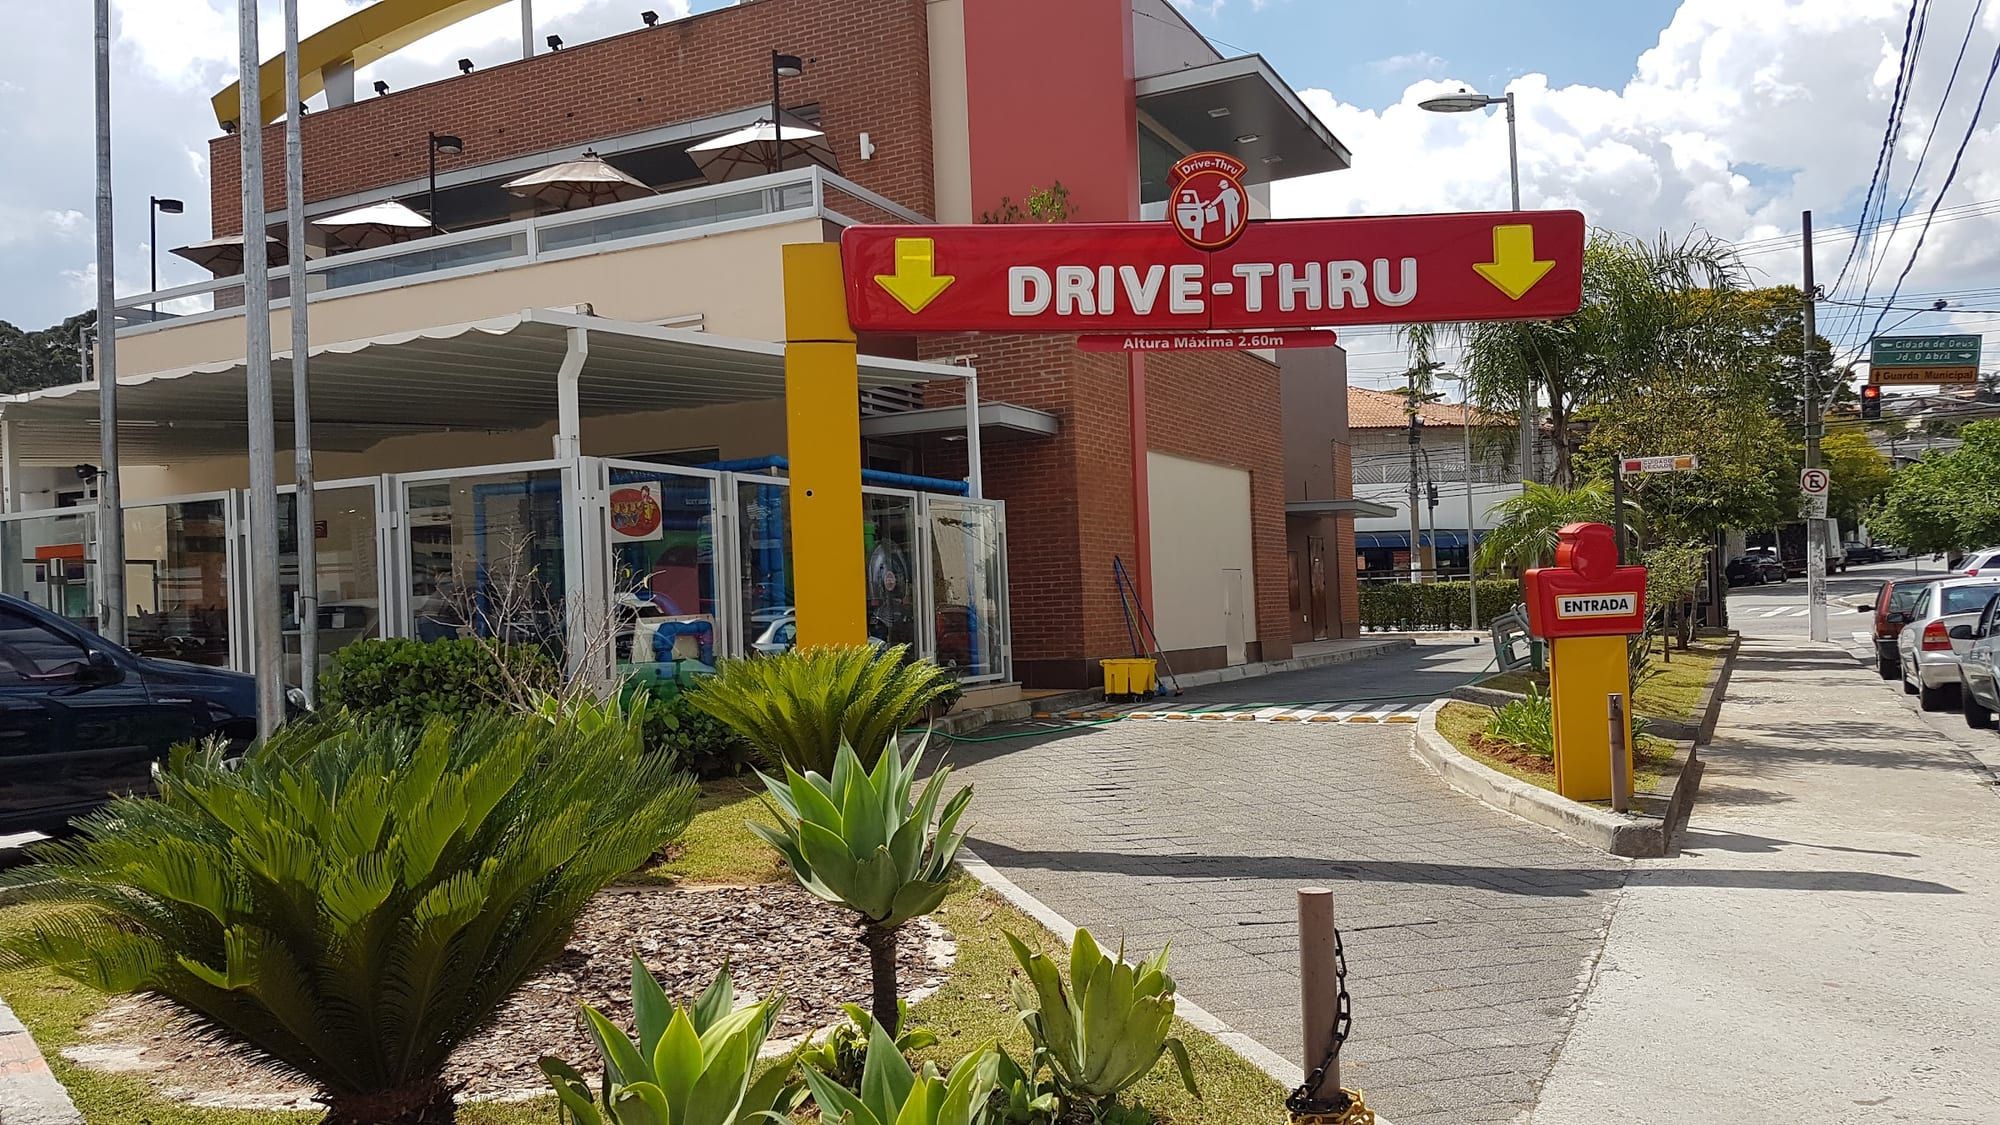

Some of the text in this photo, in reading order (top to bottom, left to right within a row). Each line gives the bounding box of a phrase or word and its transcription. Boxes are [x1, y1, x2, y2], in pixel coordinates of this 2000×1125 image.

[1181, 157, 1238, 175] Drive-Thru
[1008, 257, 1418, 316] DRIVE-THRU
[1123, 335, 1284, 349] Altura Máxima 2.60m
[1895, 339, 1974, 349] Cidade de Deus
[1883, 370, 1973, 381] Guarda Municipal
[1564, 598, 1629, 613] ENTRADA
